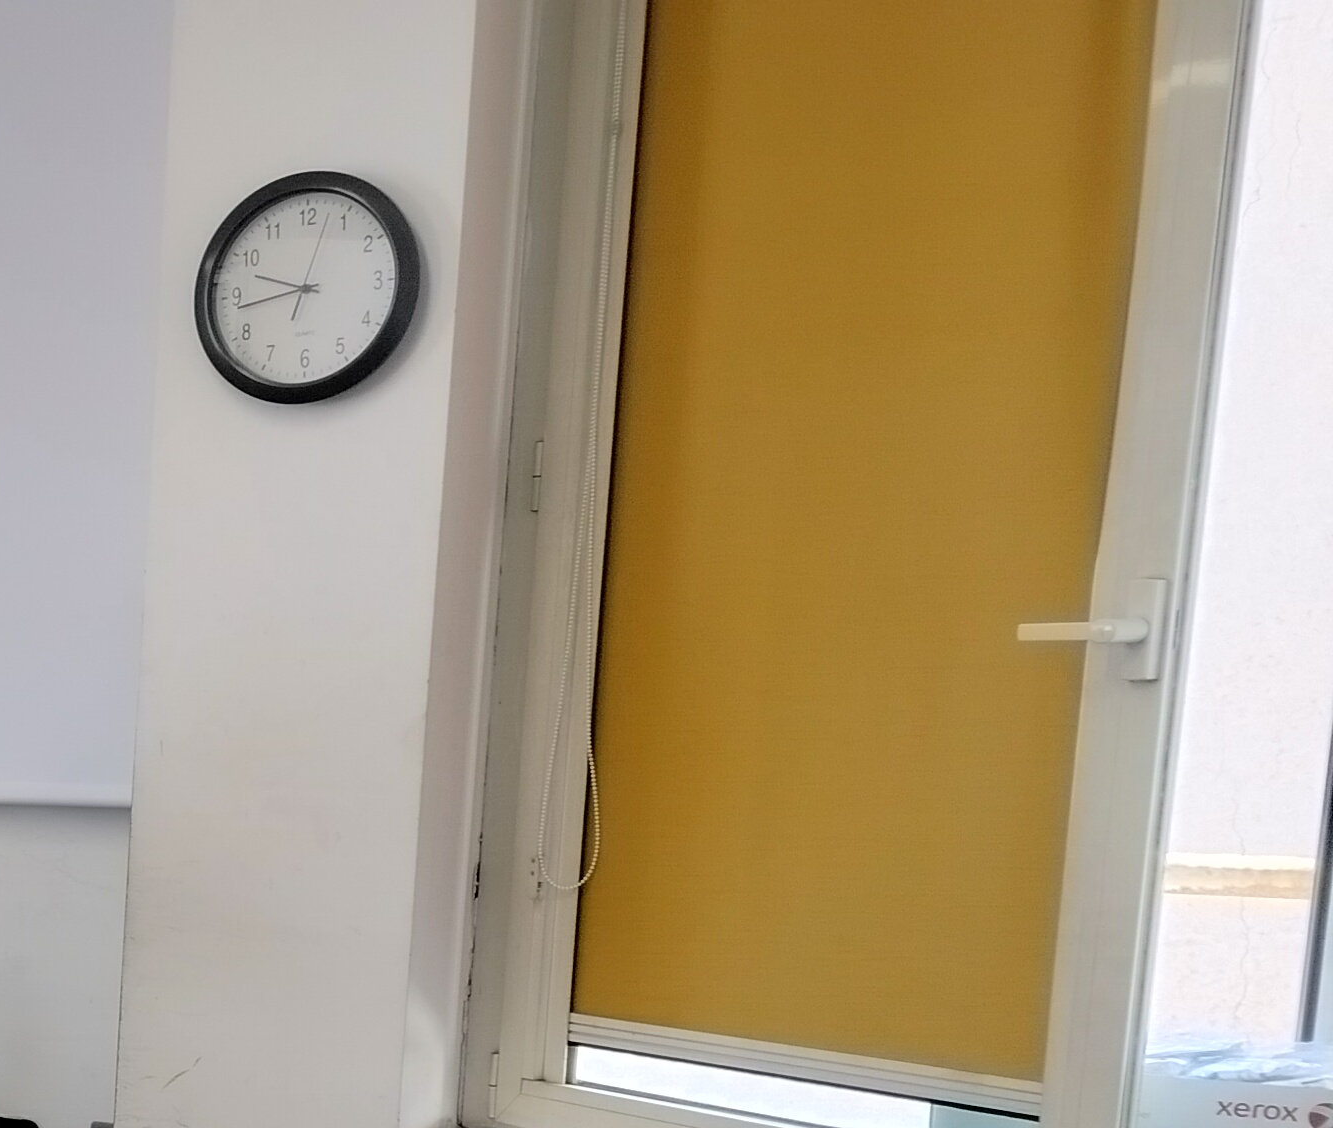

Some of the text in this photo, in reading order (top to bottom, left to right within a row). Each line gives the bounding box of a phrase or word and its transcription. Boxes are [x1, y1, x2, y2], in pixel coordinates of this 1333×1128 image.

[300, 208, 317, 226] 12
[340, 215, 346, 231] 1
[265, 224, 280, 240] 11
[363, 235, 373, 253] 2
[242, 249, 260, 267] 10
[373, 270, 383, 290] 3
[233, 287, 242, 306] 9
[361, 310, 371, 327] 4
[242, 323, 251, 340] 8
[266, 345, 275, 362] 7
[336, 337, 345, 354] 5
[300, 349, 310, 368] 6
[1216, 1100, 1299, 1122] xerox
